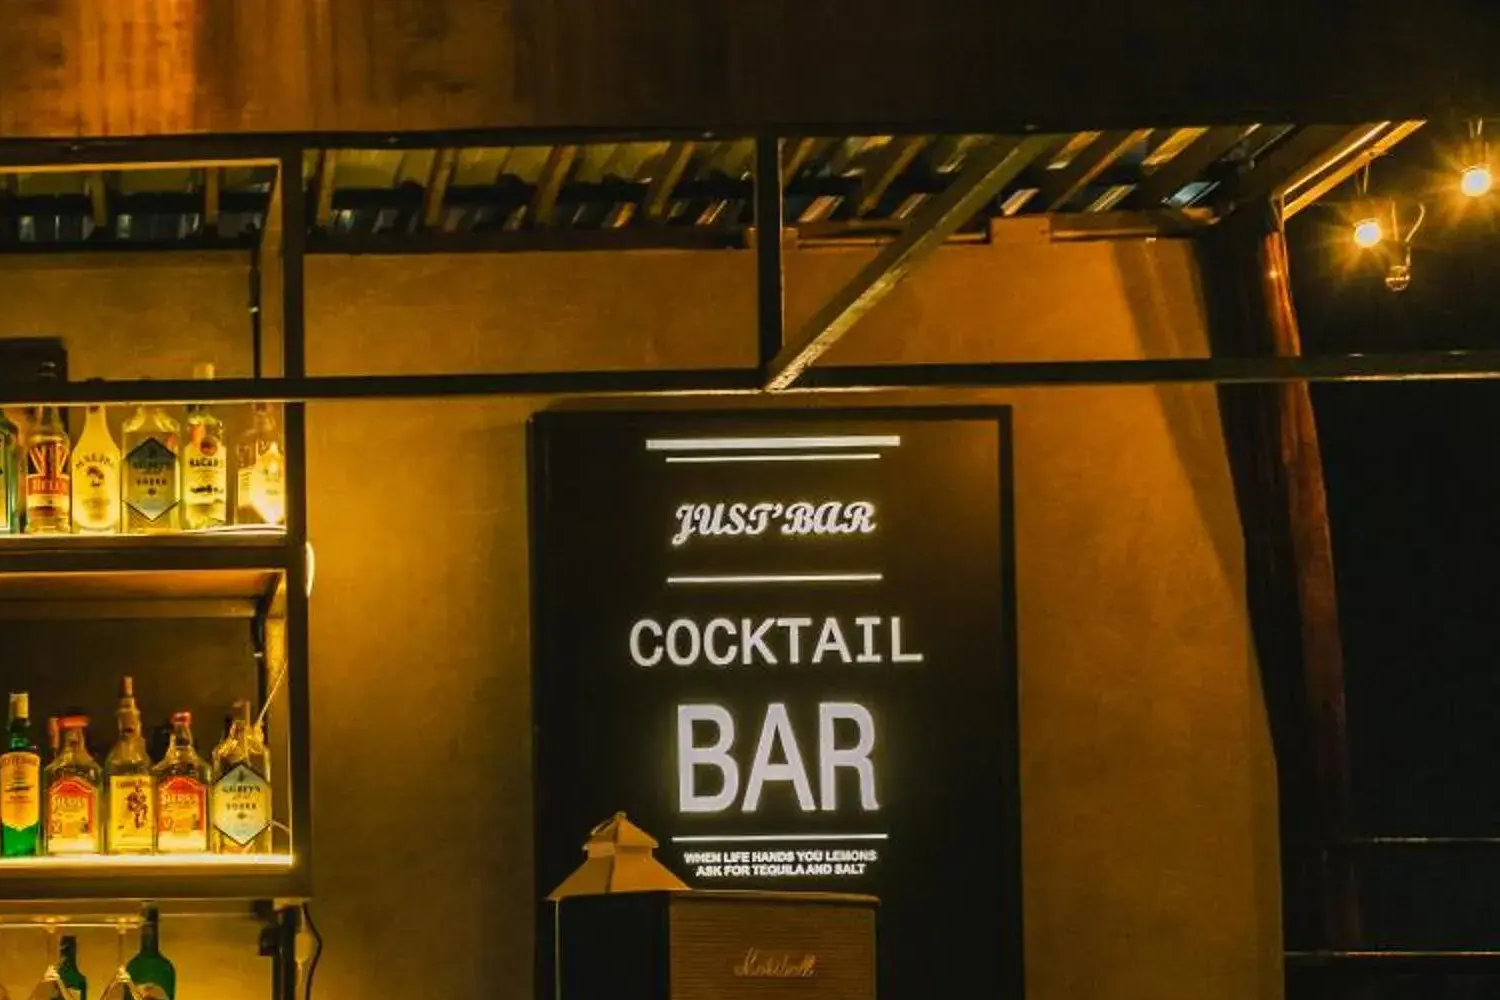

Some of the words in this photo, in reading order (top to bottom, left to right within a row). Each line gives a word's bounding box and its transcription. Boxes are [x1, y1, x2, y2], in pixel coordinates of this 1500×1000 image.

[628, 616, 924, 668] COCKTAIL
[677, 702, 881, 813] BAR
[683, 852, 722, 864] WHEN
[723, 851, 750, 863] LIFE
[751, 851, 795, 863] HANDS
[797, 850, 823, 862] YOU
[825, 849, 877, 862] LEMONS
[695, 865, 722, 877] ASK
[724, 865, 751, 876] FOR
[834, 863, 867, 875] SALT
